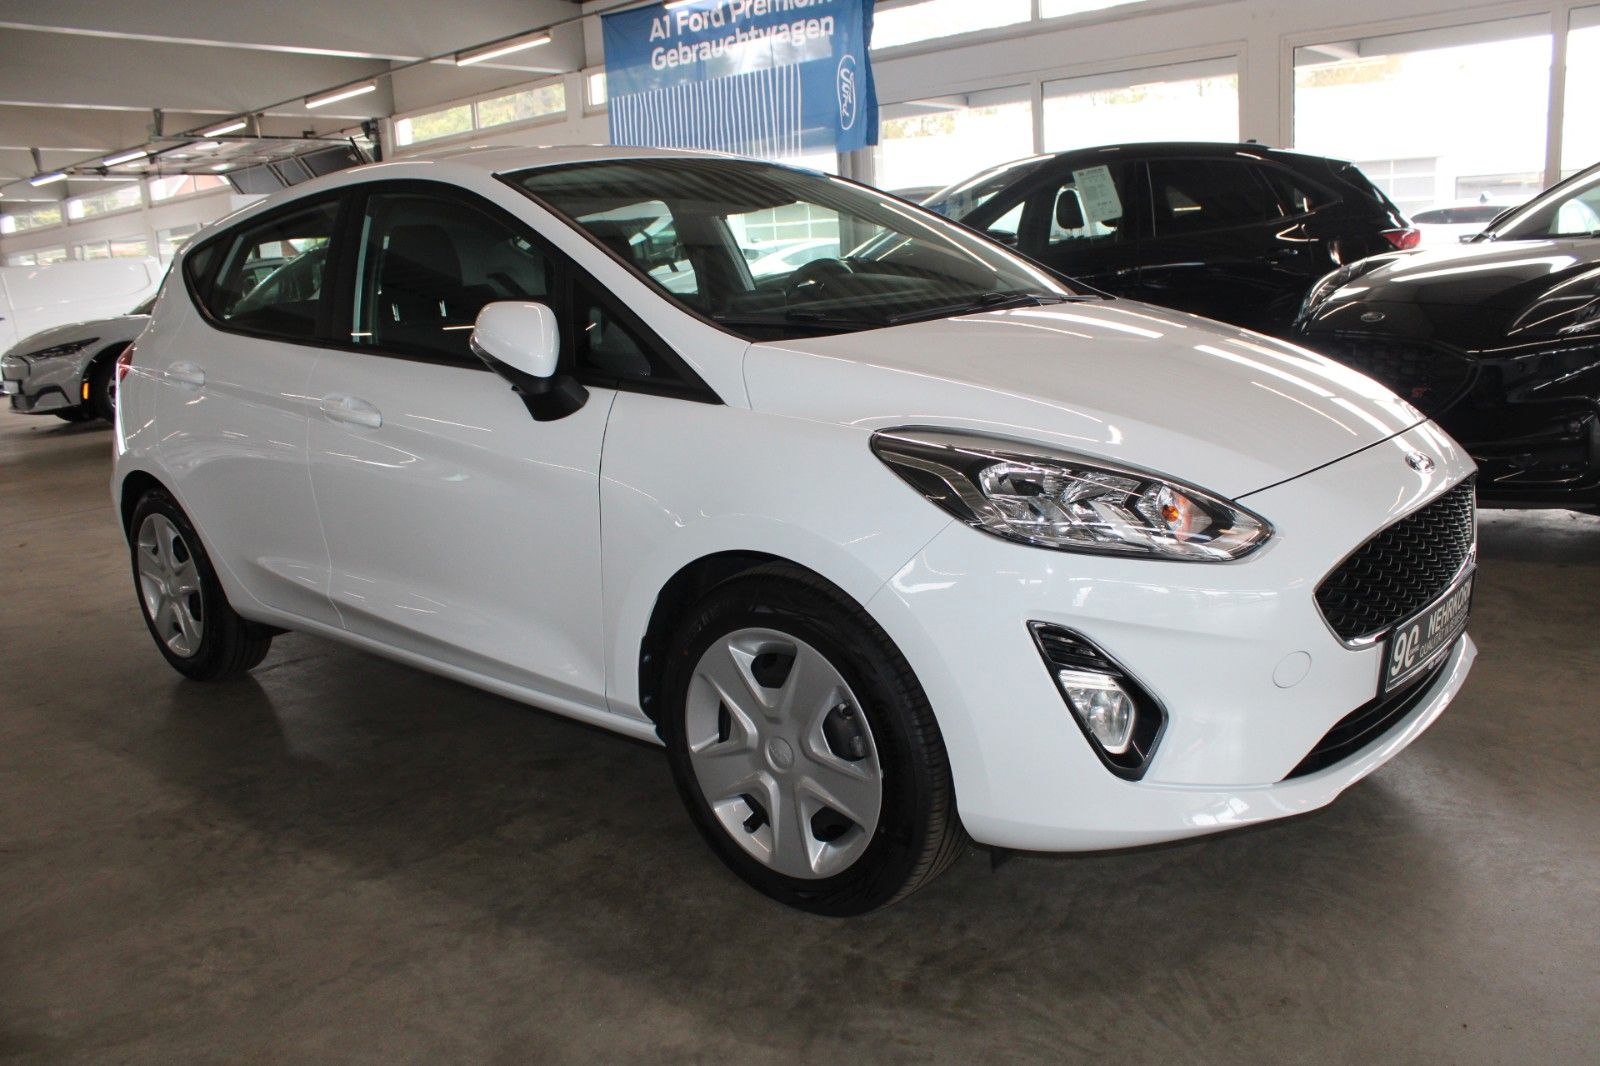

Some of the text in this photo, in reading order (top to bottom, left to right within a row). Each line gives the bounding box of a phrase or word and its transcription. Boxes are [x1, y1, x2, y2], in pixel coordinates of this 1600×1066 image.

[676, 1, 726, 36] Ford
[728, 0, 833, 23] Prem
[839, 66, 855, 118] Ford
